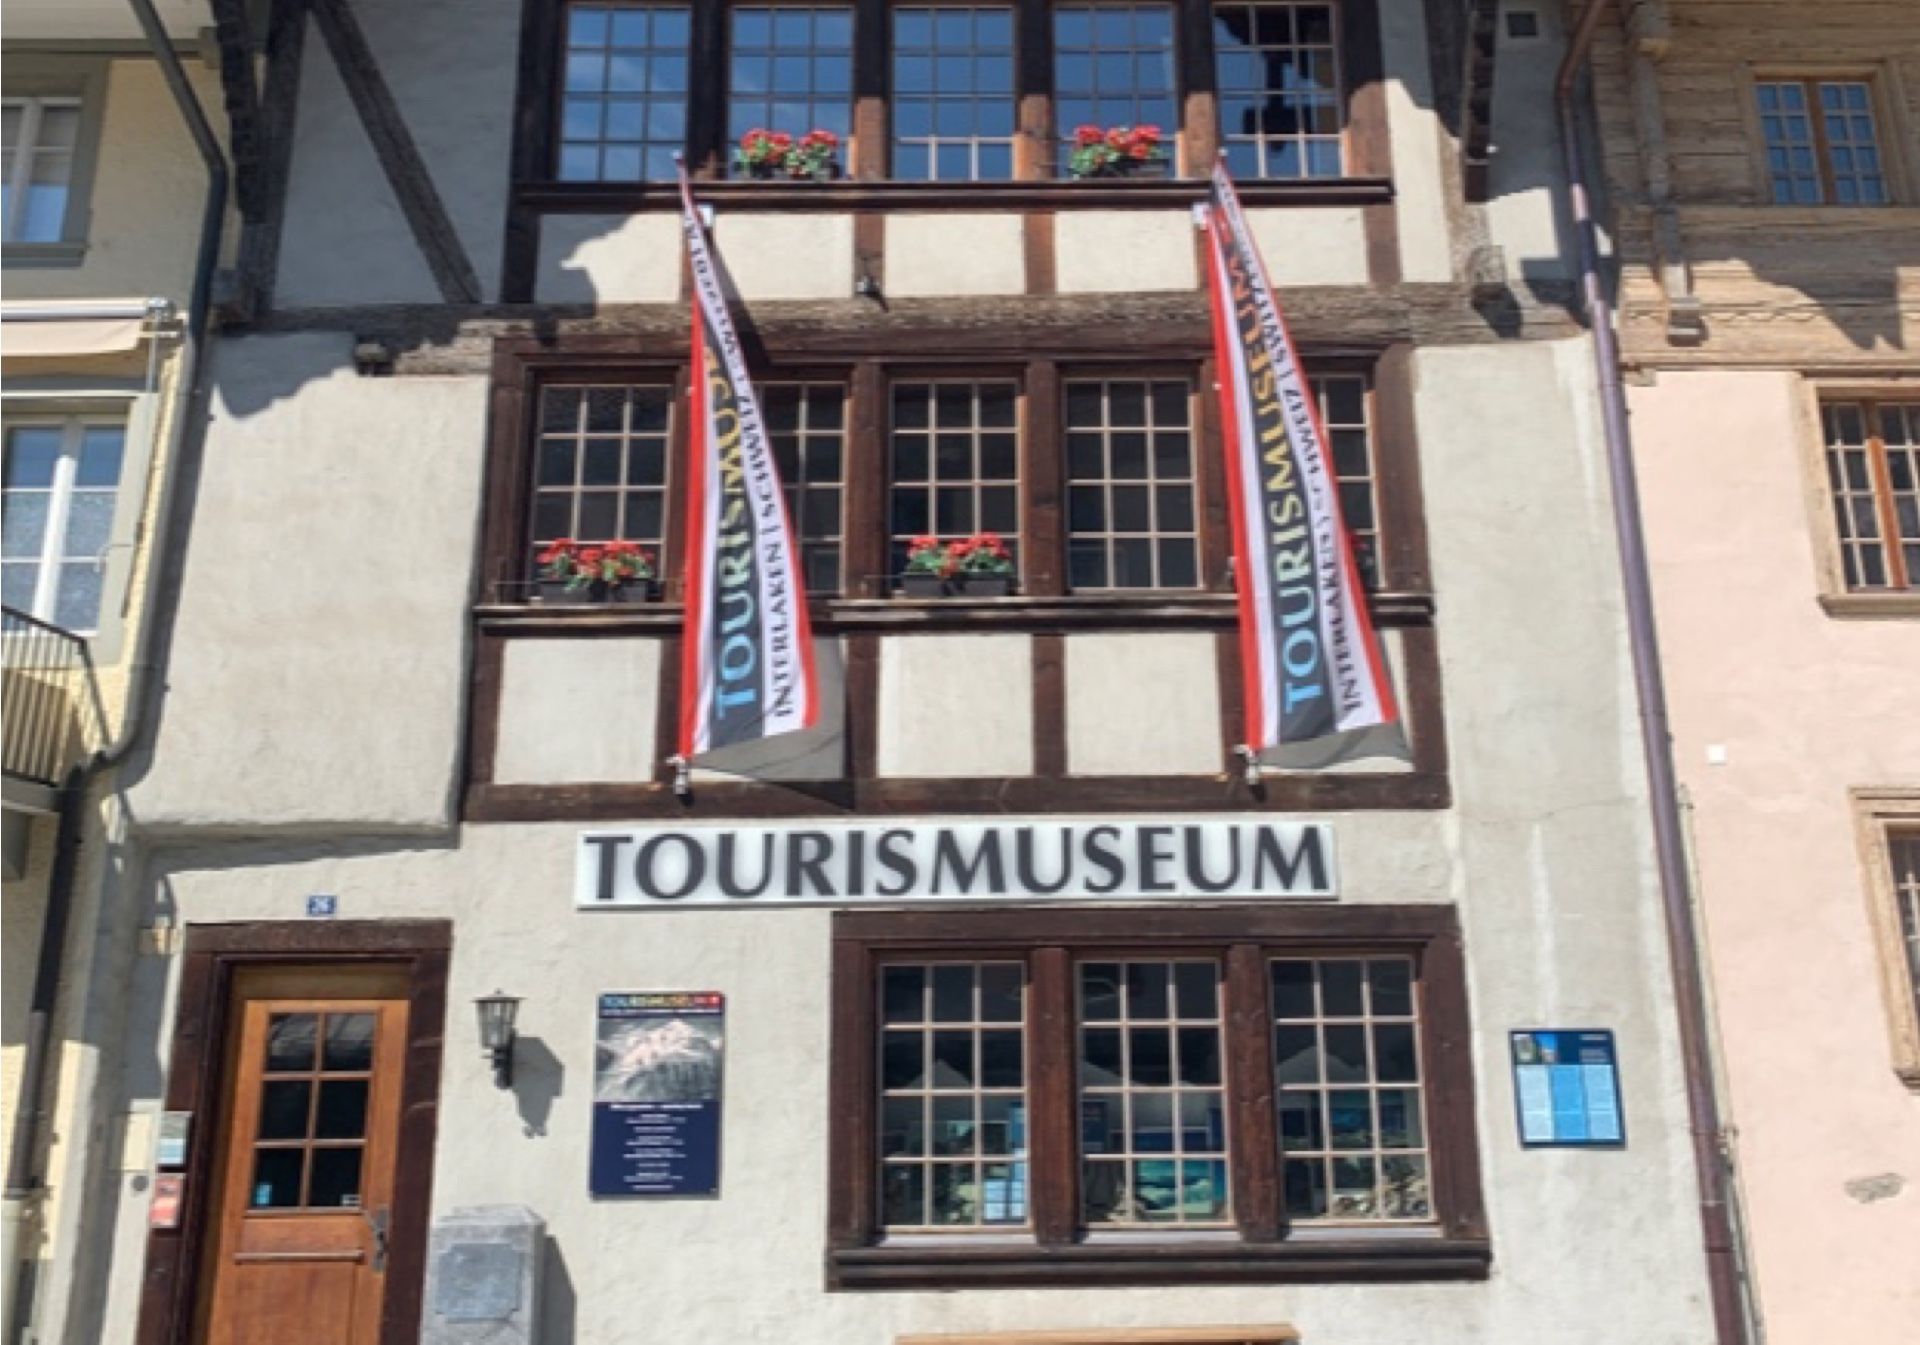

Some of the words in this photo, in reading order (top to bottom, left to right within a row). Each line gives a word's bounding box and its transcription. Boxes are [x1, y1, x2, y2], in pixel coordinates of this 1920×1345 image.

[1227, 255, 1324, 714] TOURISMUSEUM
[763, 543, 795, 719] INTERLAKEN
[584, 824, 1331, 901] TOURISMUSEUM
